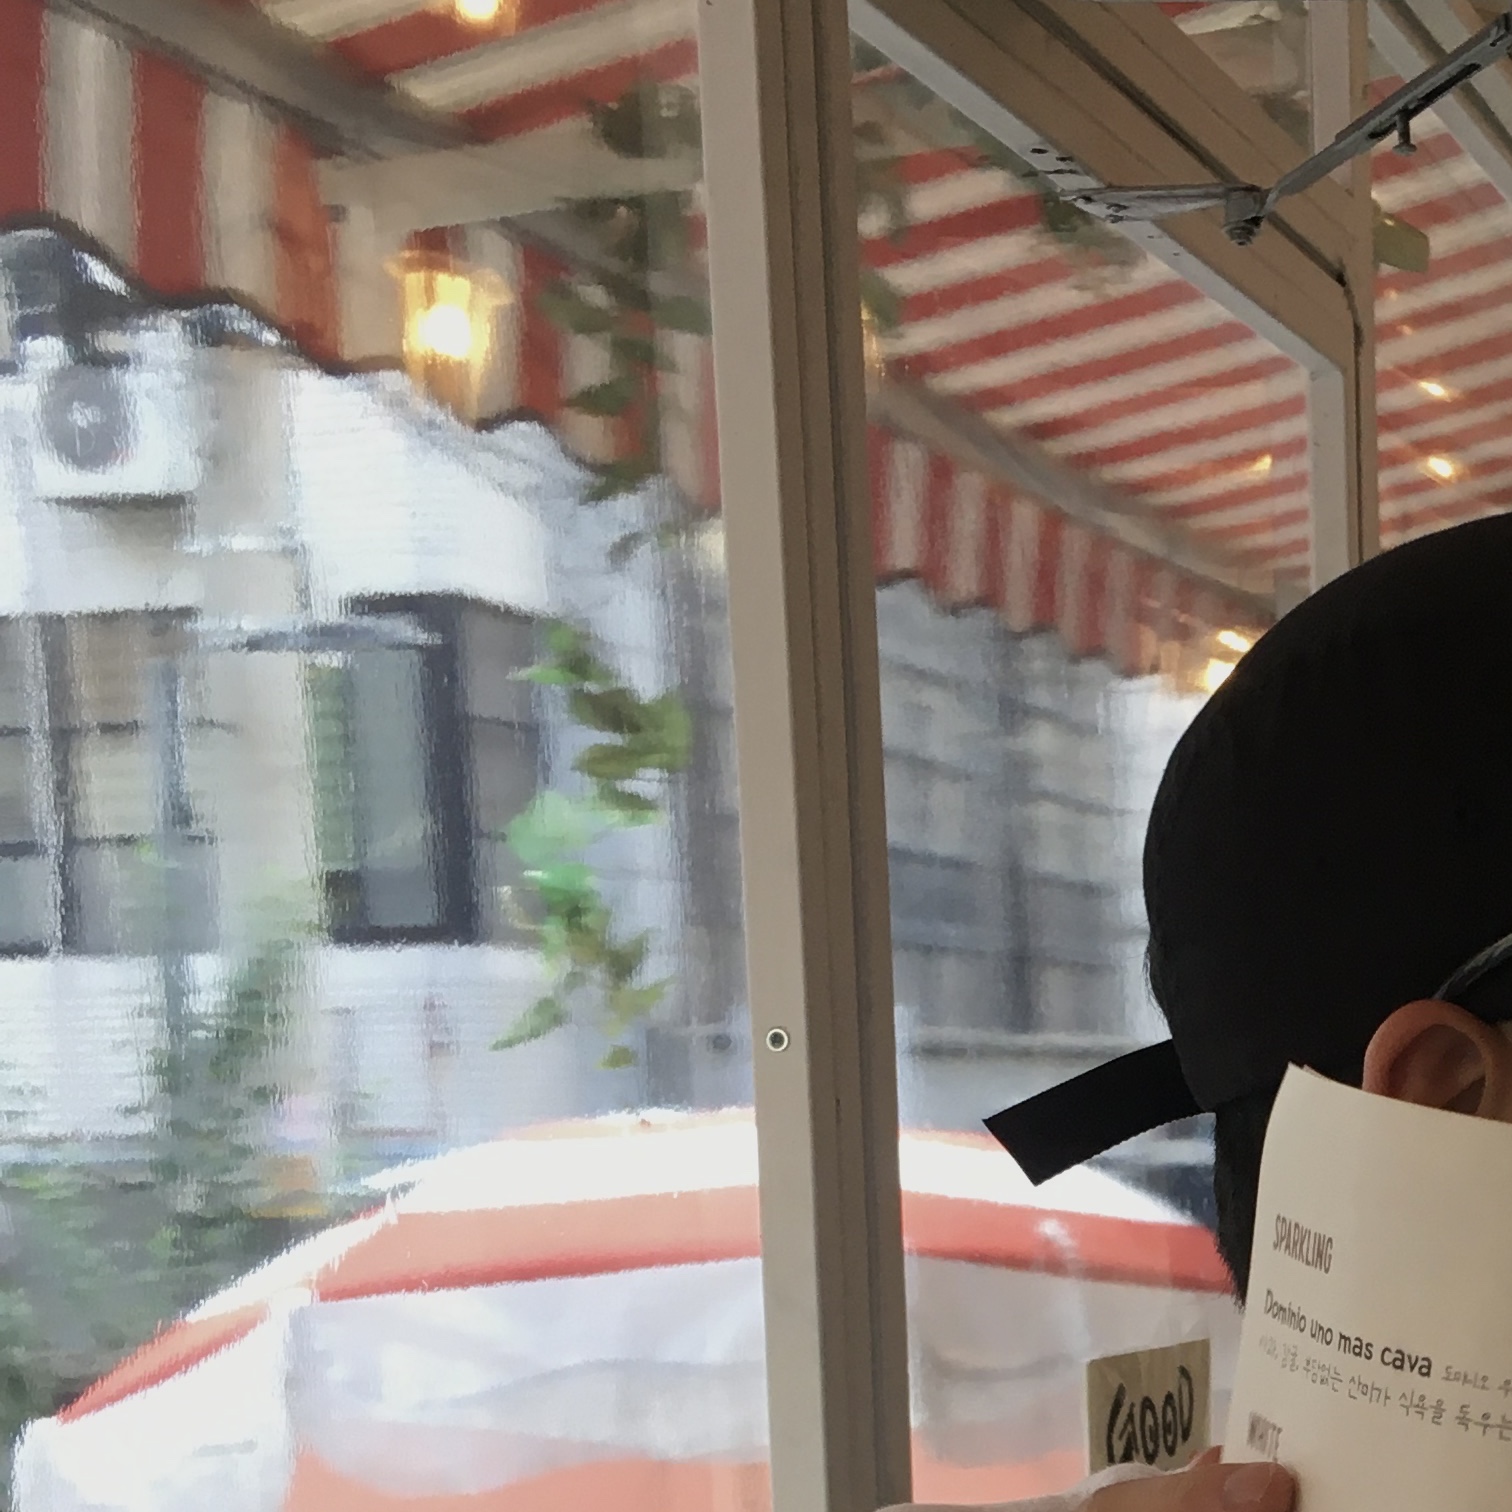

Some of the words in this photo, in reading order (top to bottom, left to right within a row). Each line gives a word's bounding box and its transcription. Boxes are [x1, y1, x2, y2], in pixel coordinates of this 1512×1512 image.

[1273, 1214, 1334, 1275] SPARKLING
[1264, 1288, 1307, 1333] Dominio
[1310, 1318, 1334, 1346] uno
[1337, 1330, 1374, 1361] mas
[1380, 1346, 1433, 1379] cava
[1348, 1374, 1391, 1408] 산미가
[1398, 1389, 1447, 1426] 식욕을
